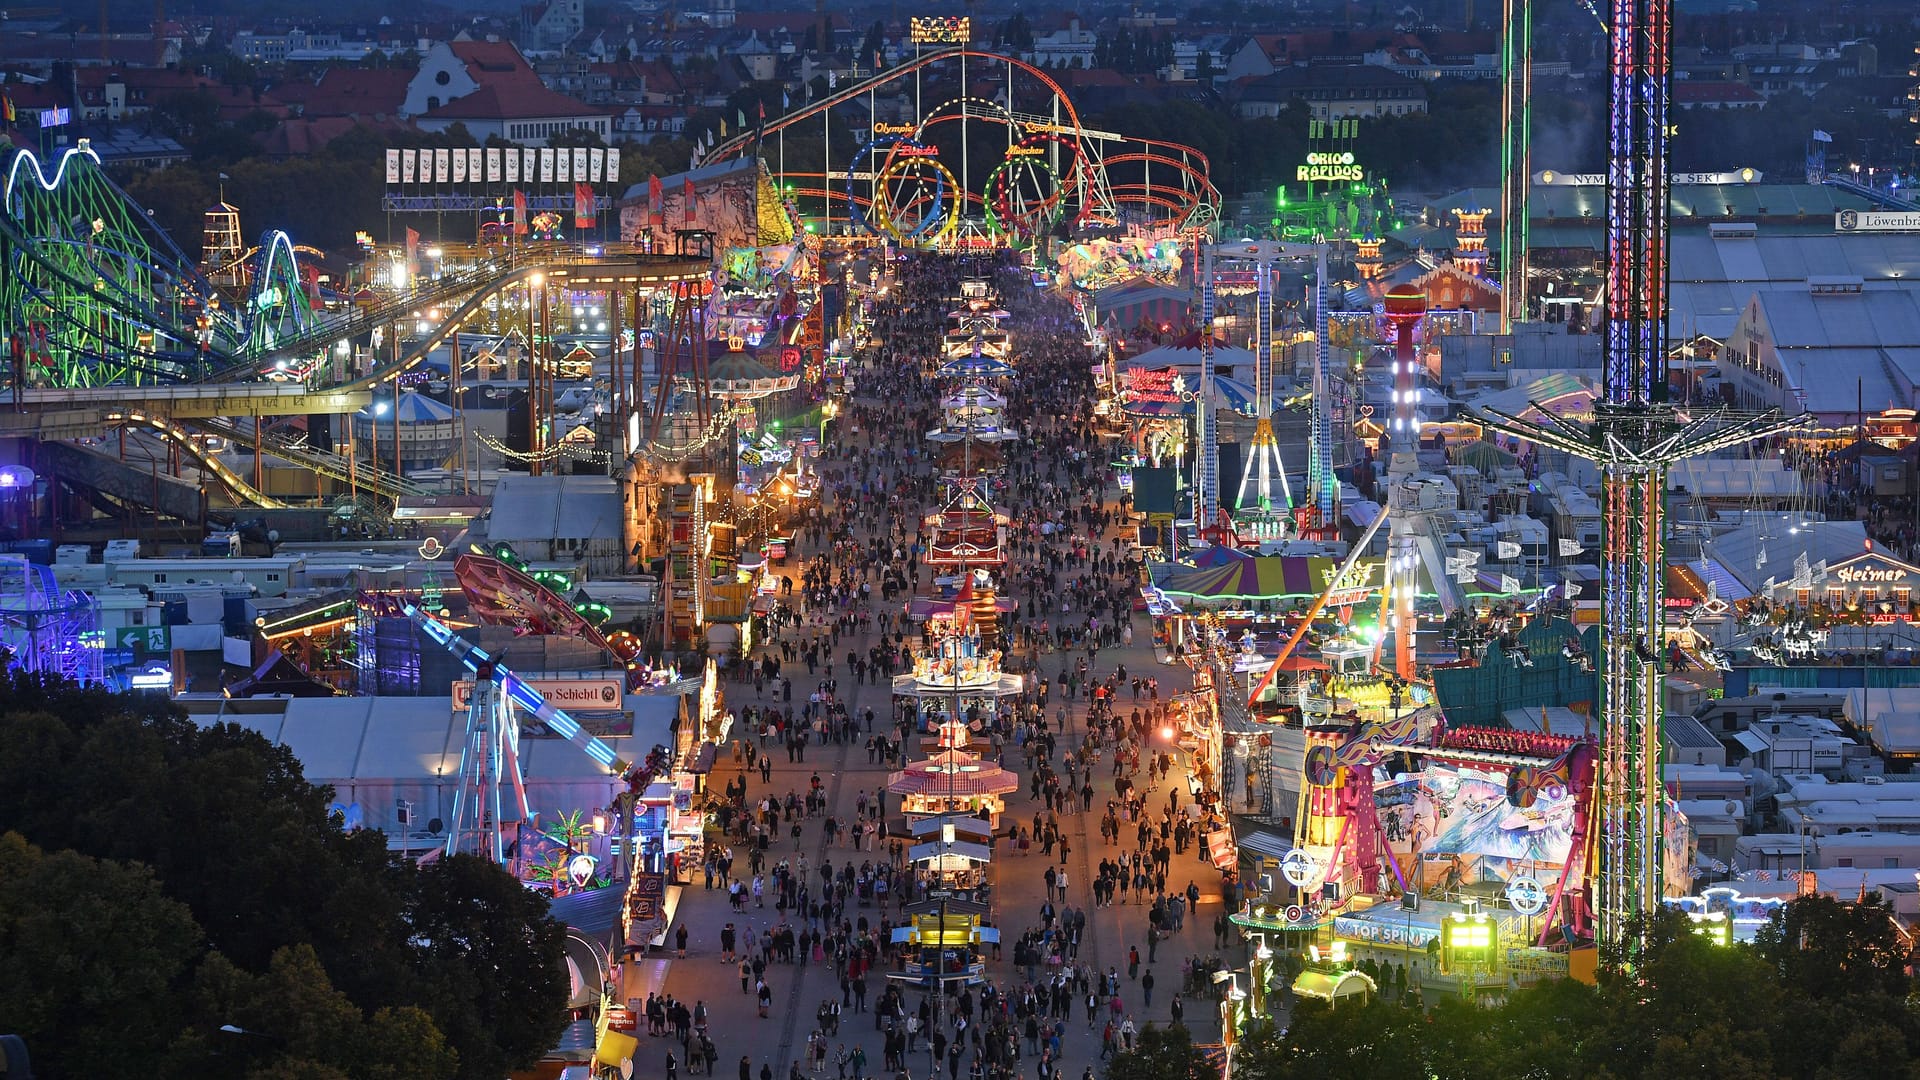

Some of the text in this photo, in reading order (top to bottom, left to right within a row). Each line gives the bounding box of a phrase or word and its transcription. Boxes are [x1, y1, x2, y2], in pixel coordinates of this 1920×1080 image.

[874, 122, 914, 134] Olympia
[1025, 121, 1066, 133] Looping
[1004, 144, 1045, 155] München
[1318, 152, 1343, 165] RIO
[1296, 165, 1364, 181] RAPIDOS
[1837, 566, 1907, 583] Heimer
[555, 687, 598, 700] Schichtl
[1352, 924, 1380, 939] TOP
[1383, 927, 1414, 943] SPIN
